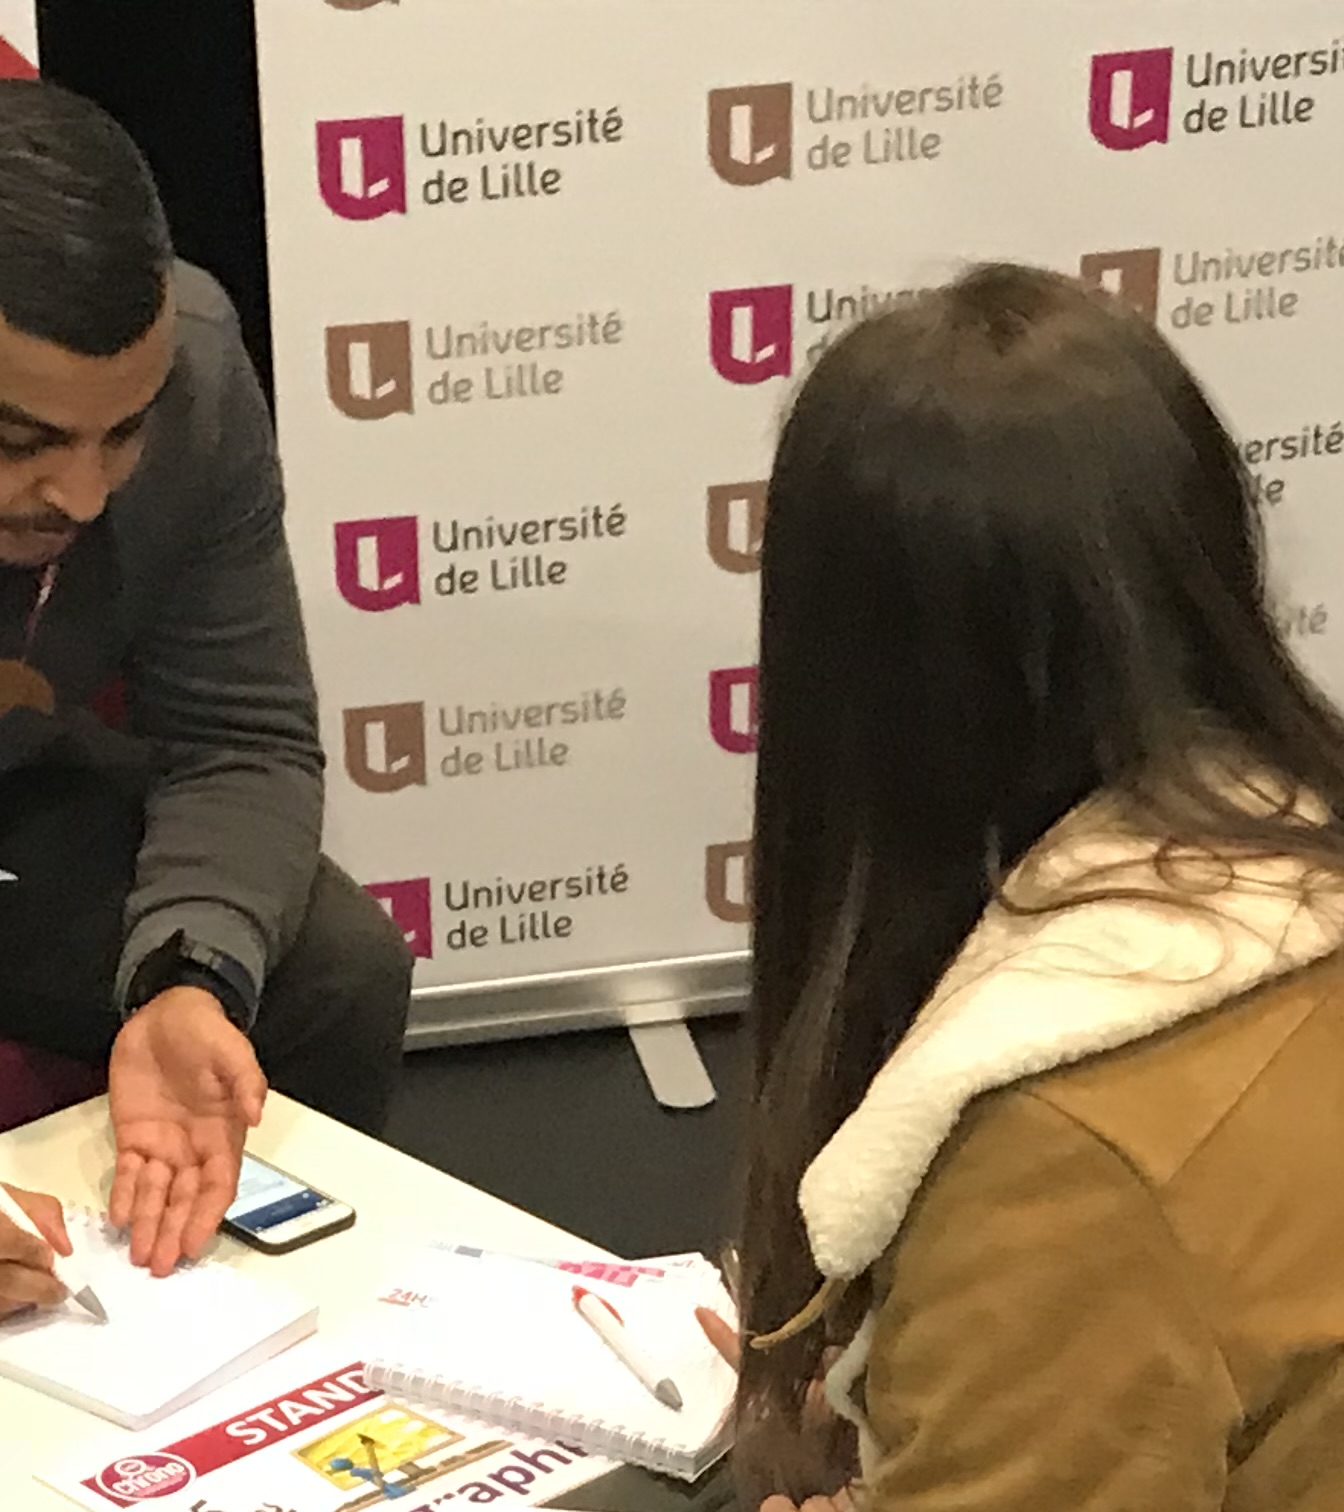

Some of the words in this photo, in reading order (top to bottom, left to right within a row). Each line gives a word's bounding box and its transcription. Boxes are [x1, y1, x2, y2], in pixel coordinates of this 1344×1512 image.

[806, 73, 1004, 124] Université
[1183, 98, 1228, 134] de
[1239, 90, 1315, 129] Lille
[420, 106, 624, 158] Université
[806, 133, 852, 172] de
[863, 126, 942, 165] Lille
[422, 169, 469, 206] de
[481, 160, 562, 201] Lille
[1170, 296, 1215, 330] de
[1224, 286, 1299, 324] Lille
[425, 310, 624, 361] Université
[427, 370, 474, 406] de
[484, 361, 564, 400] Lille
[1242, 421, 1344, 464] ersité
[432, 502, 627, 554] Université
[434, 563, 479, 597] de
[490, 554, 568, 591] Lille
[438, 687, 627, 737] Université
[439, 745, 484, 778] de
[494, 736, 570, 772] Lille
[444, 863, 629, 912] Université
[446, 919, 489, 951] de
[499, 910, 573, 945] Lille
